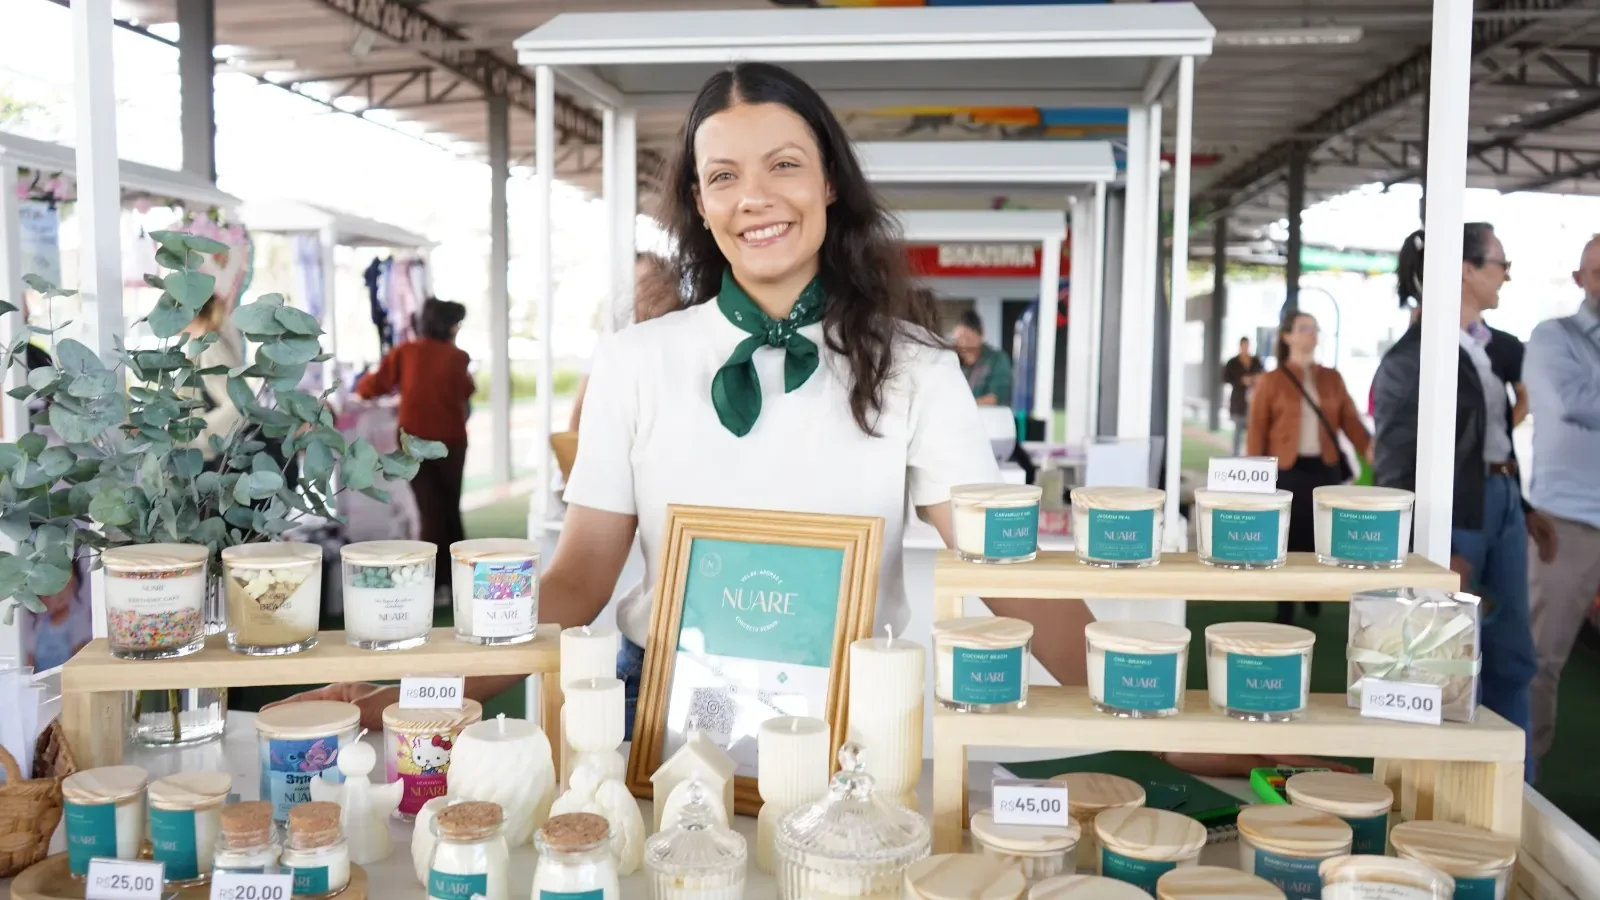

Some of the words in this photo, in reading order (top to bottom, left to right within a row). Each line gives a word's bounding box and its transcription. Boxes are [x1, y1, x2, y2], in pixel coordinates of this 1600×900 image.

[1104, 530, 1138, 541] NUARE
[1228, 530, 1263, 541] NUARE
[1347, 529, 1383, 542] NUARE
[721, 586, 800, 616] NUARE
[378, 612, 410, 622] NUARE
[970, 671, 1007, 683] NUARE
[1121, 675, 1160, 689] NUARE
[1246, 677, 1285, 690] NUARE
[406, 686, 456, 700] R$80,00
[1369, 693, 1433, 712] R$25,00
[1000, 797, 1061, 814] R$45,00
[95, 874, 154, 892] R$25,00
